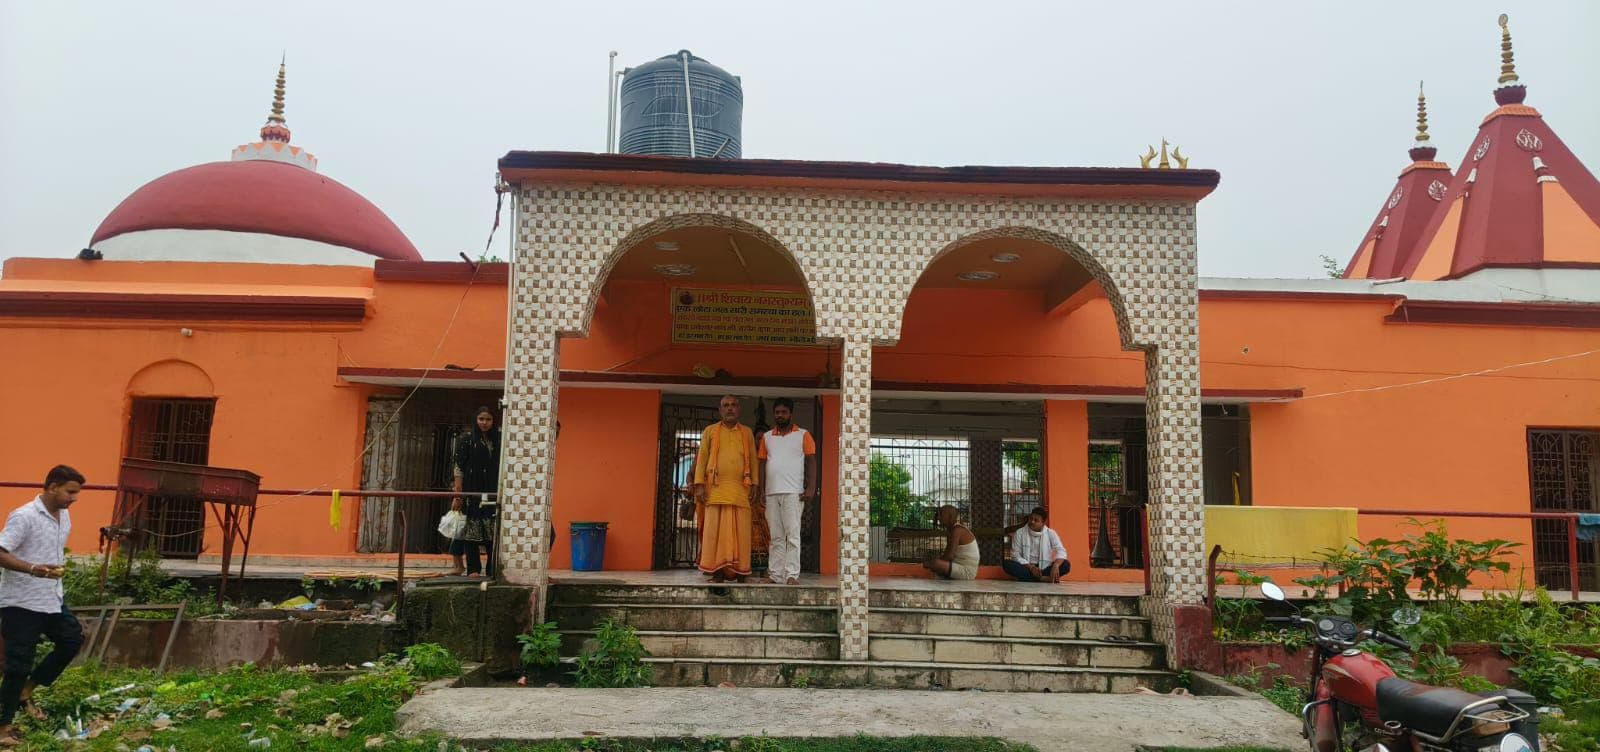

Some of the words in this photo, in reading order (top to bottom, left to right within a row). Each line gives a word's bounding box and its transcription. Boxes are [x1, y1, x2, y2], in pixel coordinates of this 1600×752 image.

[722, 292, 752, 303] शिवाय
[693, 304, 712, 313] लोटा
[730, 305, 747, 314] सारी
